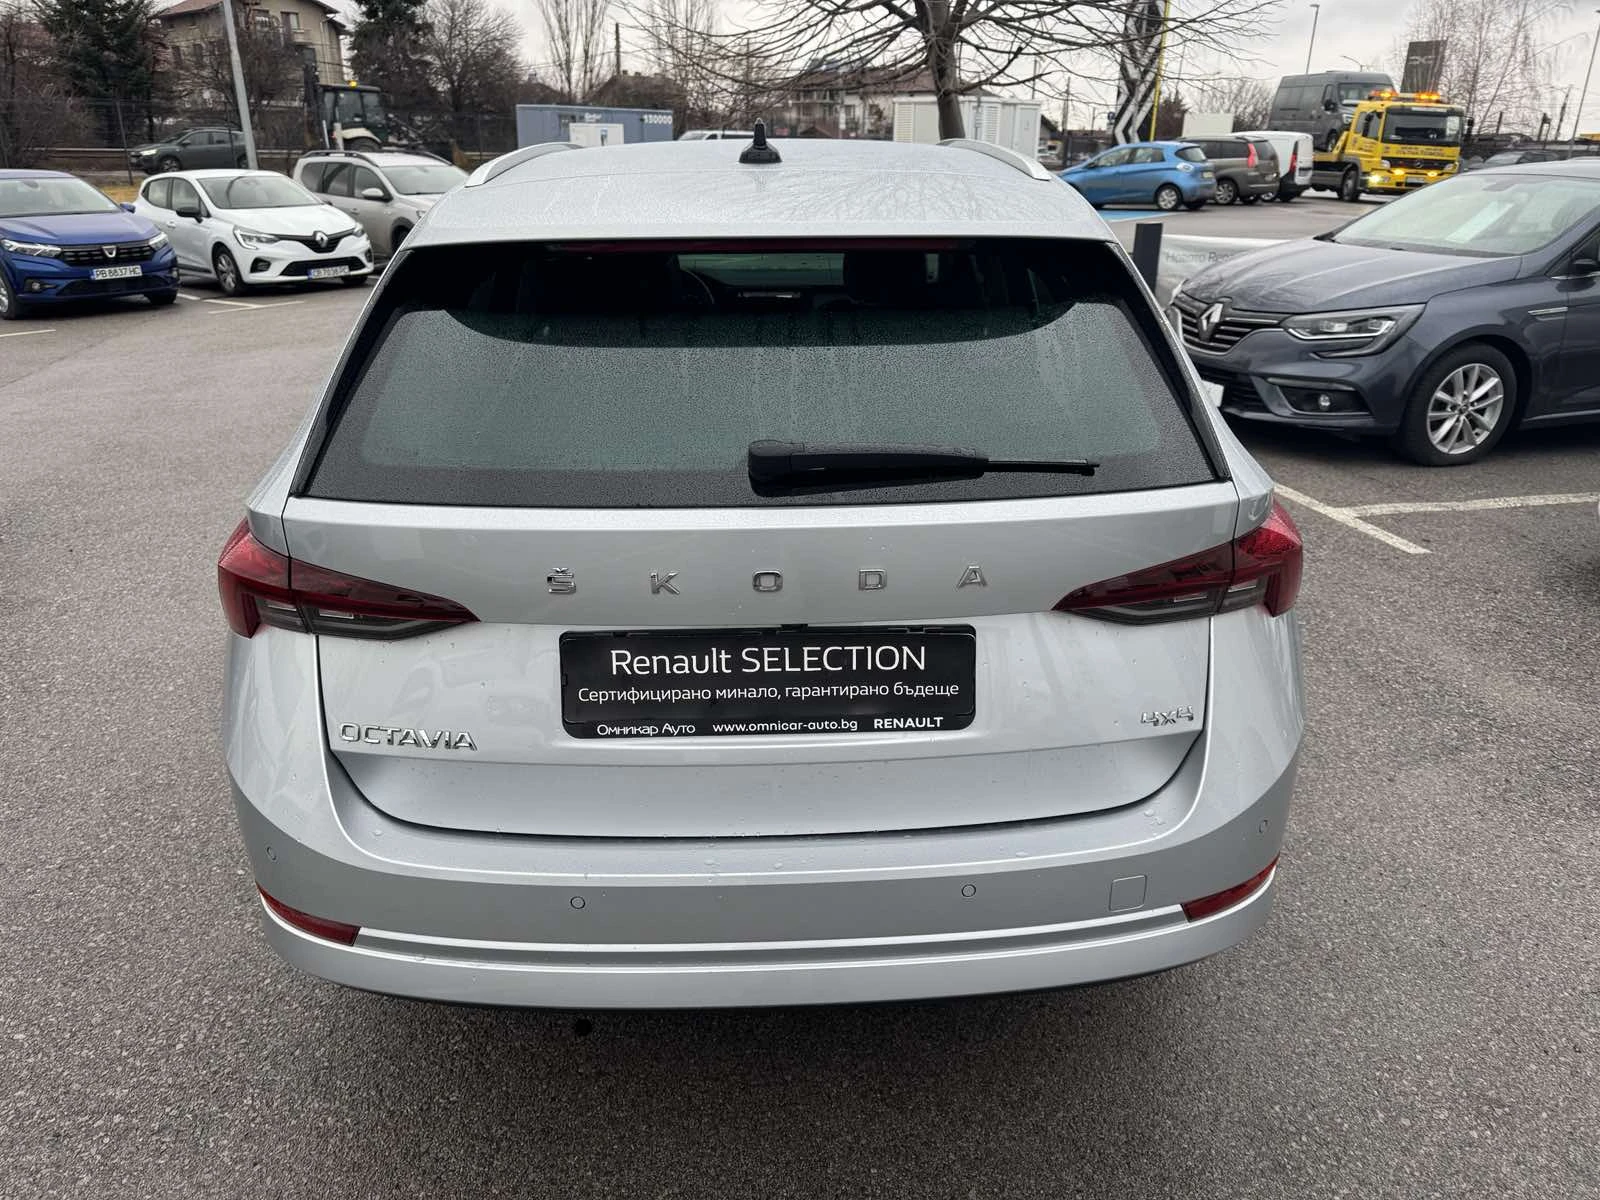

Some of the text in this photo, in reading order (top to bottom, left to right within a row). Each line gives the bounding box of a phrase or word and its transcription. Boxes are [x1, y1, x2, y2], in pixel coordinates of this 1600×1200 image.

[610, 645, 926, 676] Renault SELECTION
[578, 681, 960, 704] Сертифицирано минало, гарантирано бъдеще
[596, 722, 696, 737] Омникар Ауто
[712, 718, 858, 732] www.omnicar-auto.bg
[873, 716, 944, 729] RENAULT
[340, 722, 478, 751] OCTAVIA
